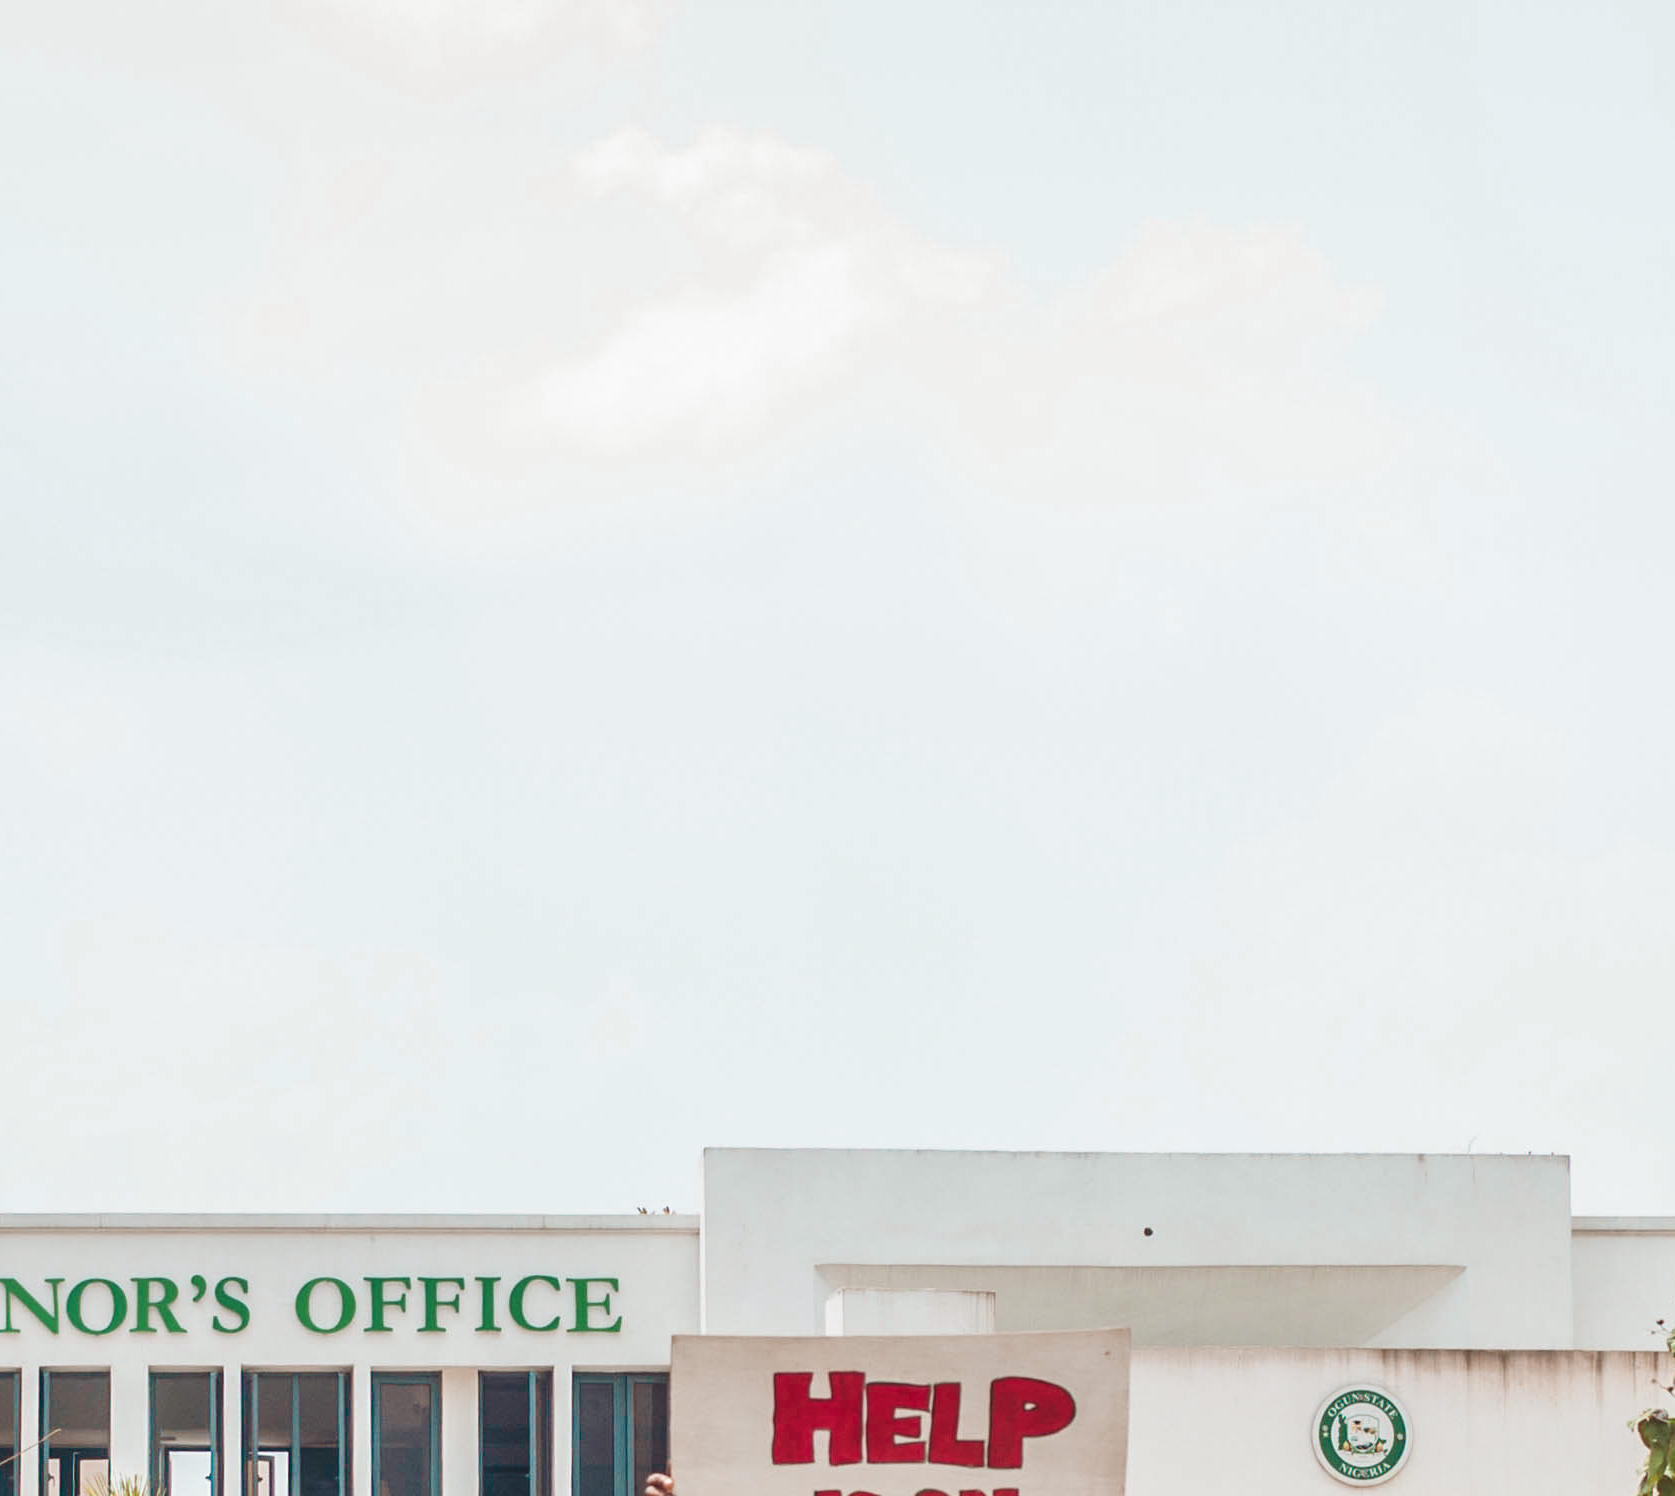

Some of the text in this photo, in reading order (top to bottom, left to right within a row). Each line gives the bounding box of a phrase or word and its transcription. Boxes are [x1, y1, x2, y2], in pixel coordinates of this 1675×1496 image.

[295, 1275, 624, 1335] OFFICE
[772, 1371, 1076, 1471] HELP
[1327, 1392, 1399, 1421] OGUN STATE
[1340, 1462, 1392, 1479] NIGERIA
